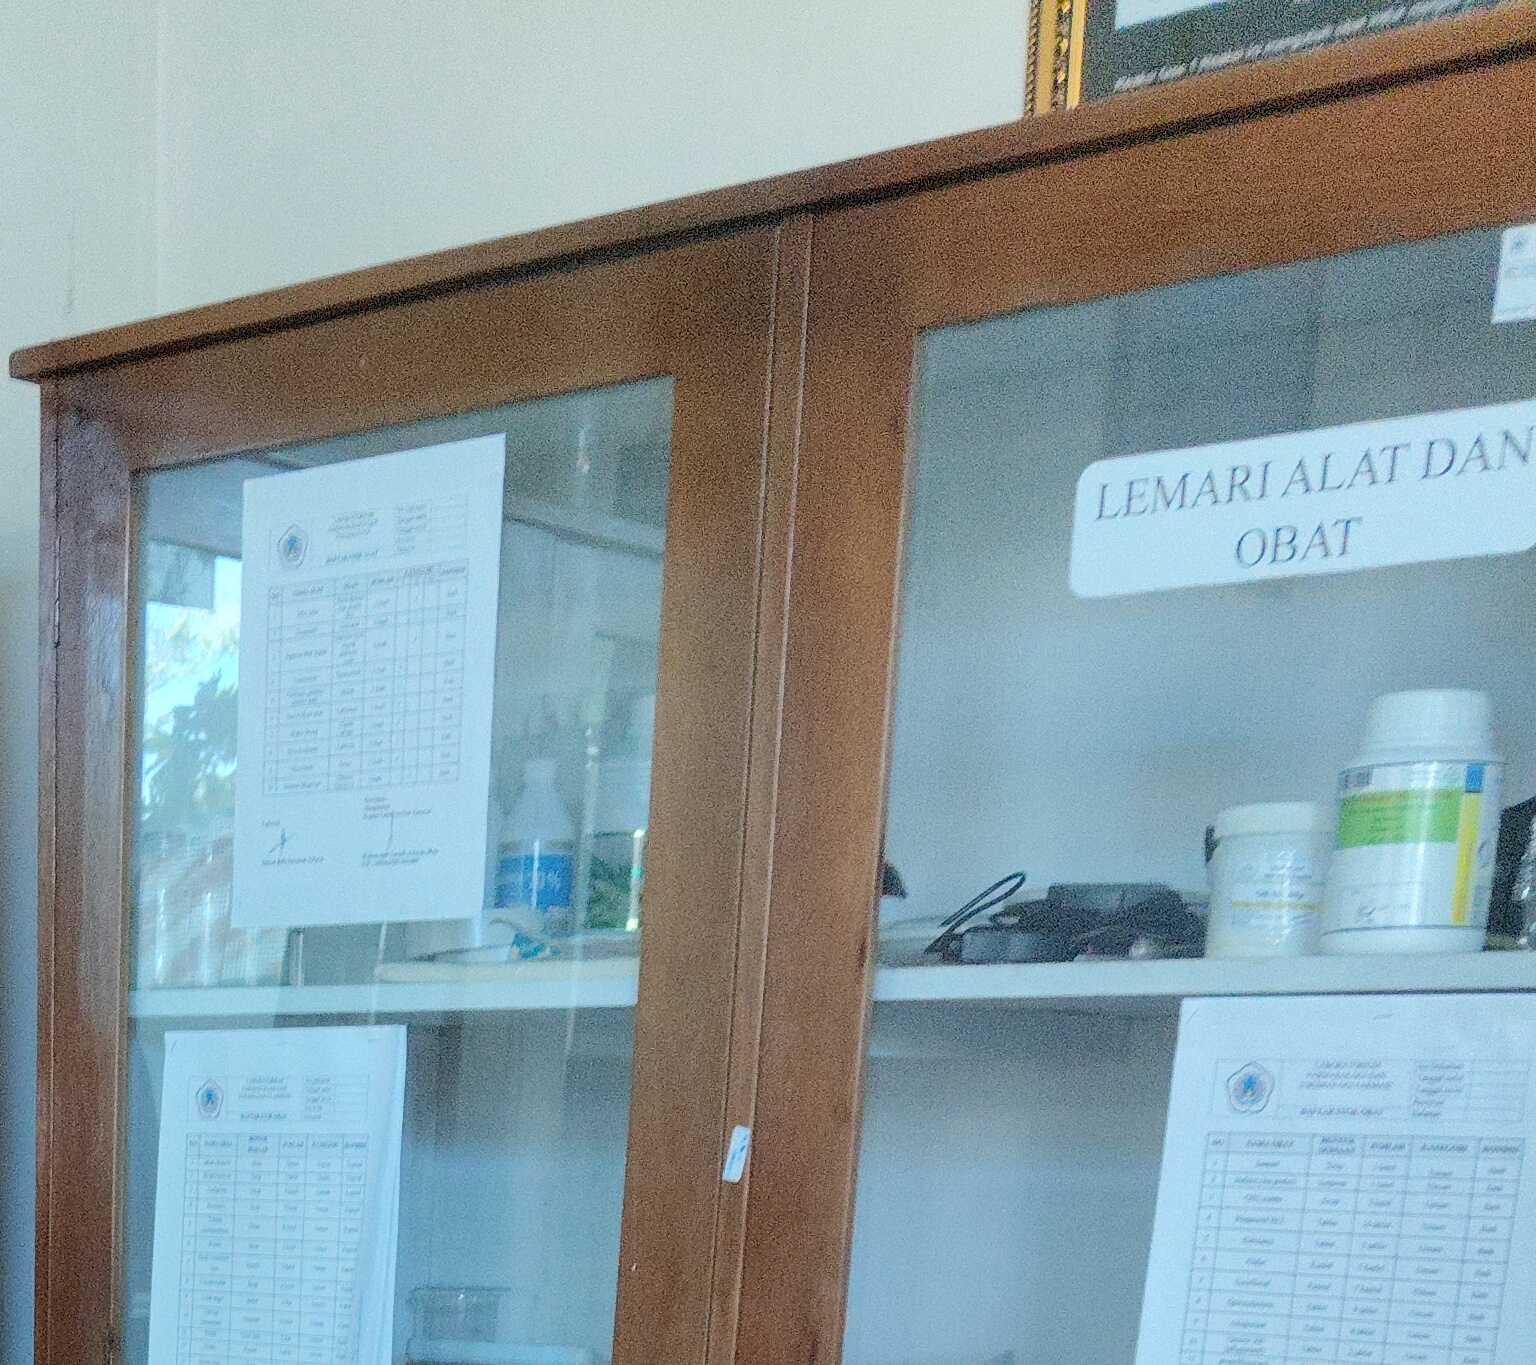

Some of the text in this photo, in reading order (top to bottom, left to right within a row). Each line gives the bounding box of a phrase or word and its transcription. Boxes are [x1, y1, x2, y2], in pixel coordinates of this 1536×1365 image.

[1095, 426, 1536, 521] LEMARI ALAT DAN
[1234, 516, 1364, 569] OBAT
